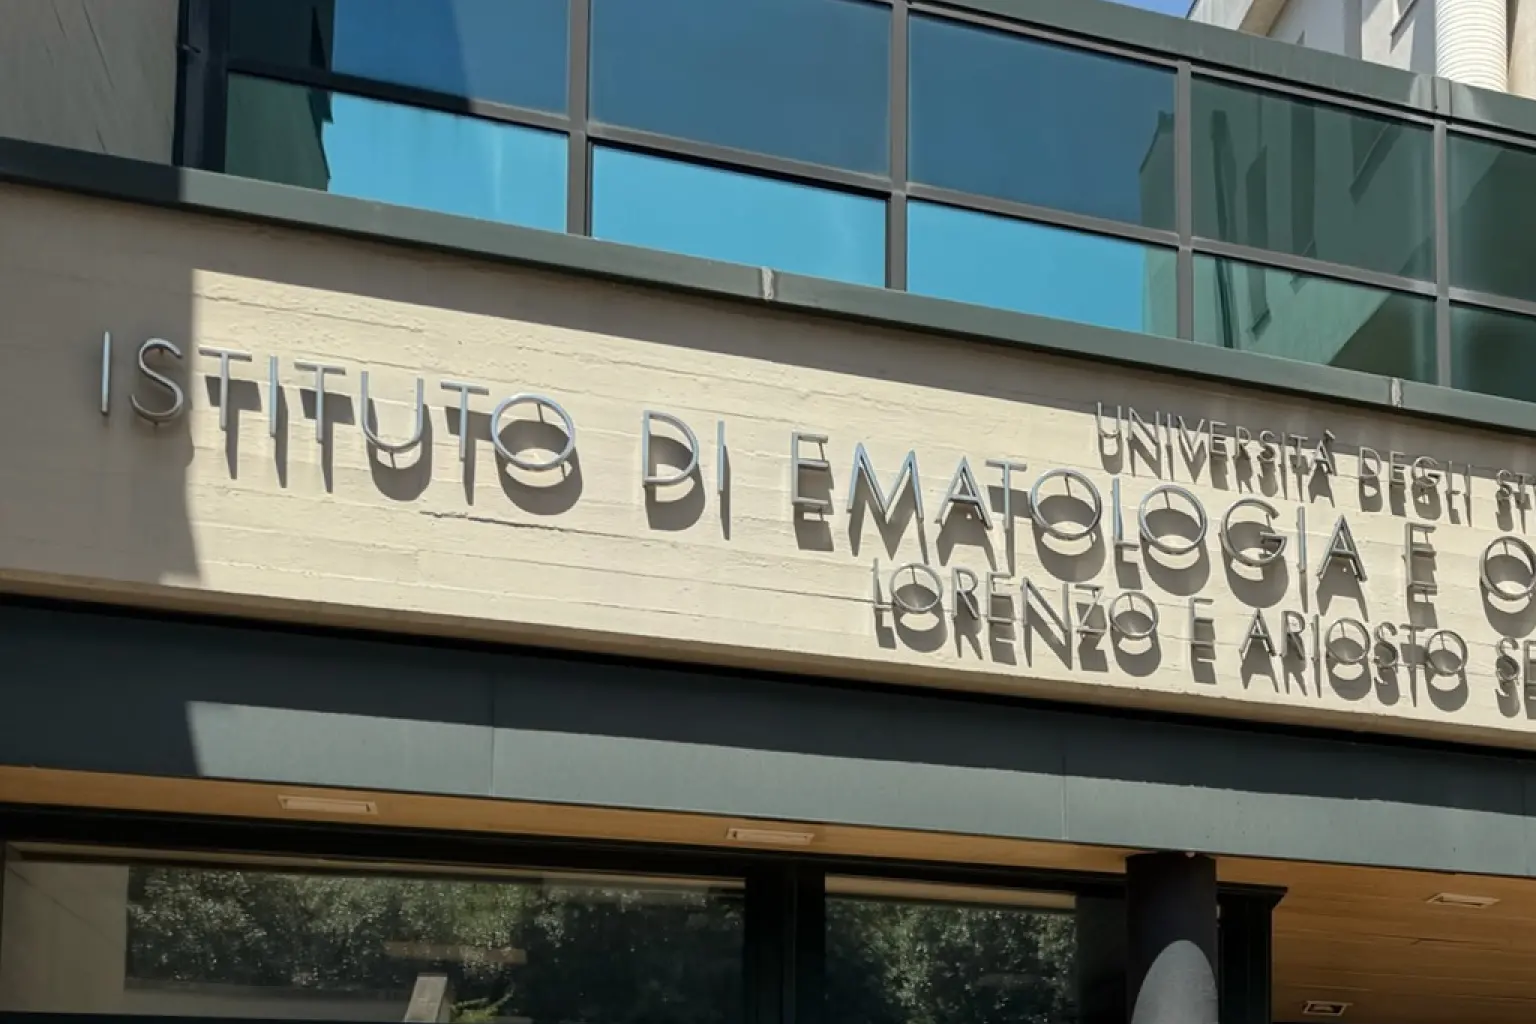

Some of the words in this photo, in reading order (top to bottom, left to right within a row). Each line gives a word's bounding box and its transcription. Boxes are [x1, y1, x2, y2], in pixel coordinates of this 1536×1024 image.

[100, 330, 576, 471] ISTITUTO
[643, 409, 725, 495] DI
[790, 430, 1367, 582] EMATOLOGIA
[1404, 521, 1438, 596] E
[1359, 446, 1471, 496] DEGLI
[873, 557, 1158, 640] LORENZO
[1189, 597, 1214, 645] E
[1238, 608, 1468, 676] ARIOSTO
